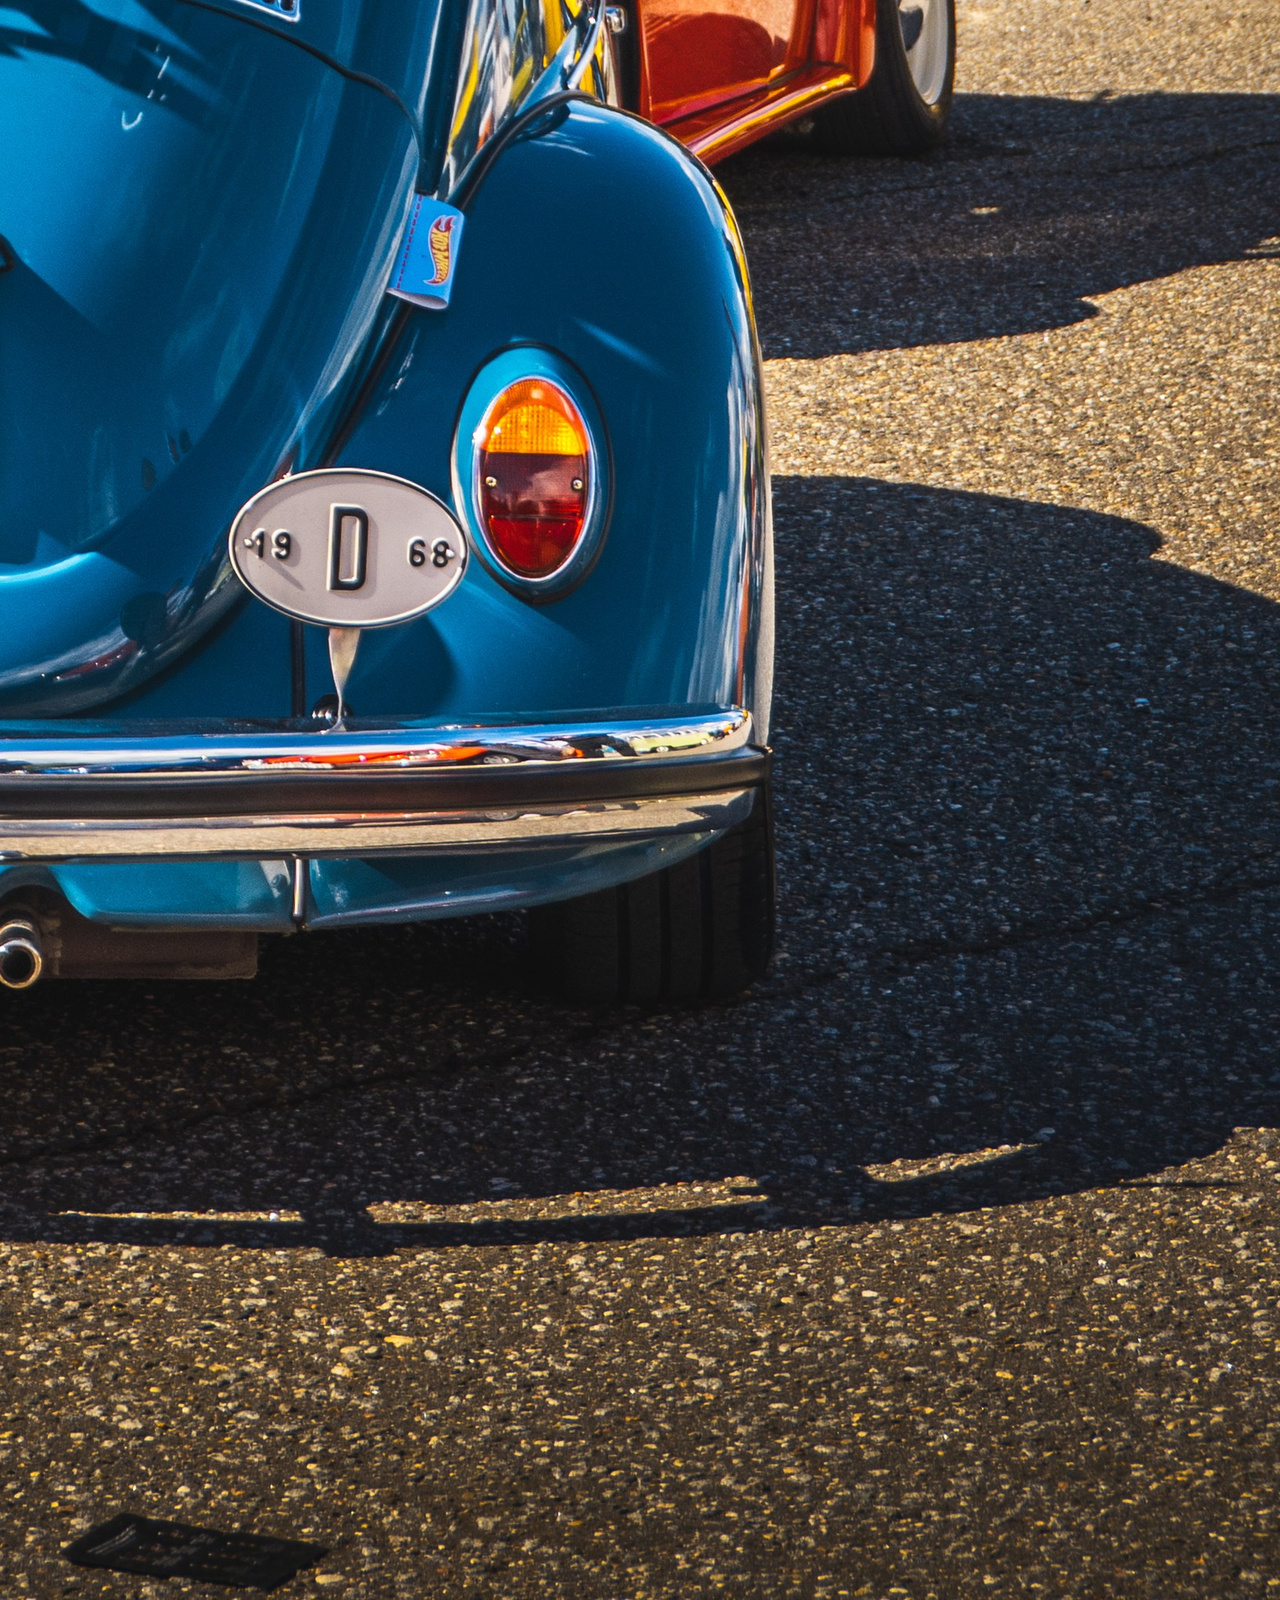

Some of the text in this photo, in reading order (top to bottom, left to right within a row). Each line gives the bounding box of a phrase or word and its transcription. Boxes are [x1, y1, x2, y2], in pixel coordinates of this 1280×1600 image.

[251, 502, 451, 592] 19 D 68
